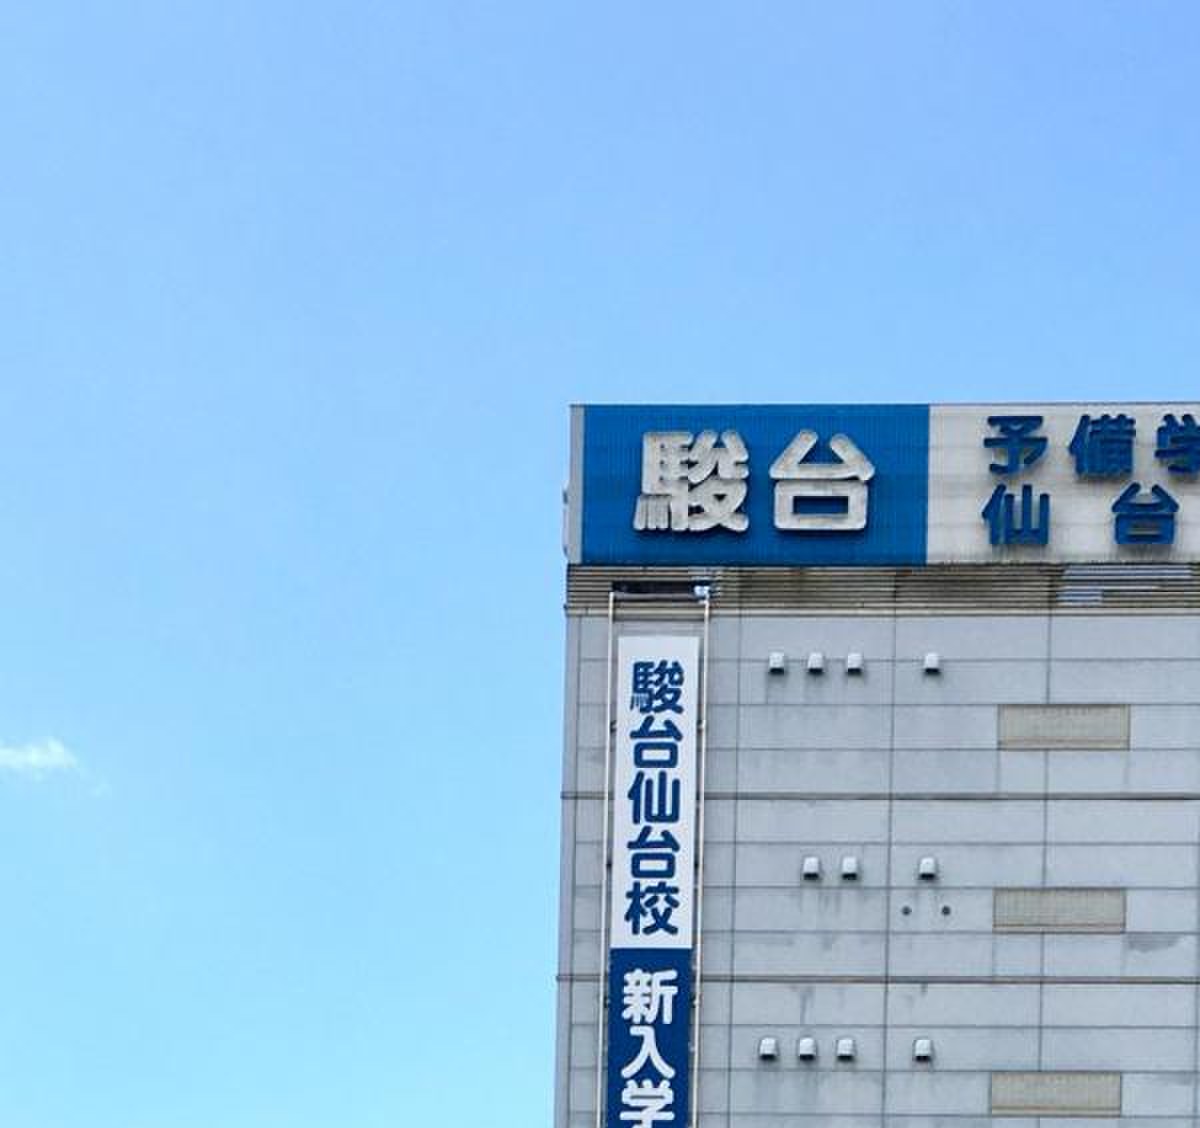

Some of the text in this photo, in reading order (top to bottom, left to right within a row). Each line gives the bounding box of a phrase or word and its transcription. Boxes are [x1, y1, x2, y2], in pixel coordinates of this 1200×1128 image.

[634, 427, 876, 534] 駿台
[624, 659, 685, 936] 駿台仙台校
